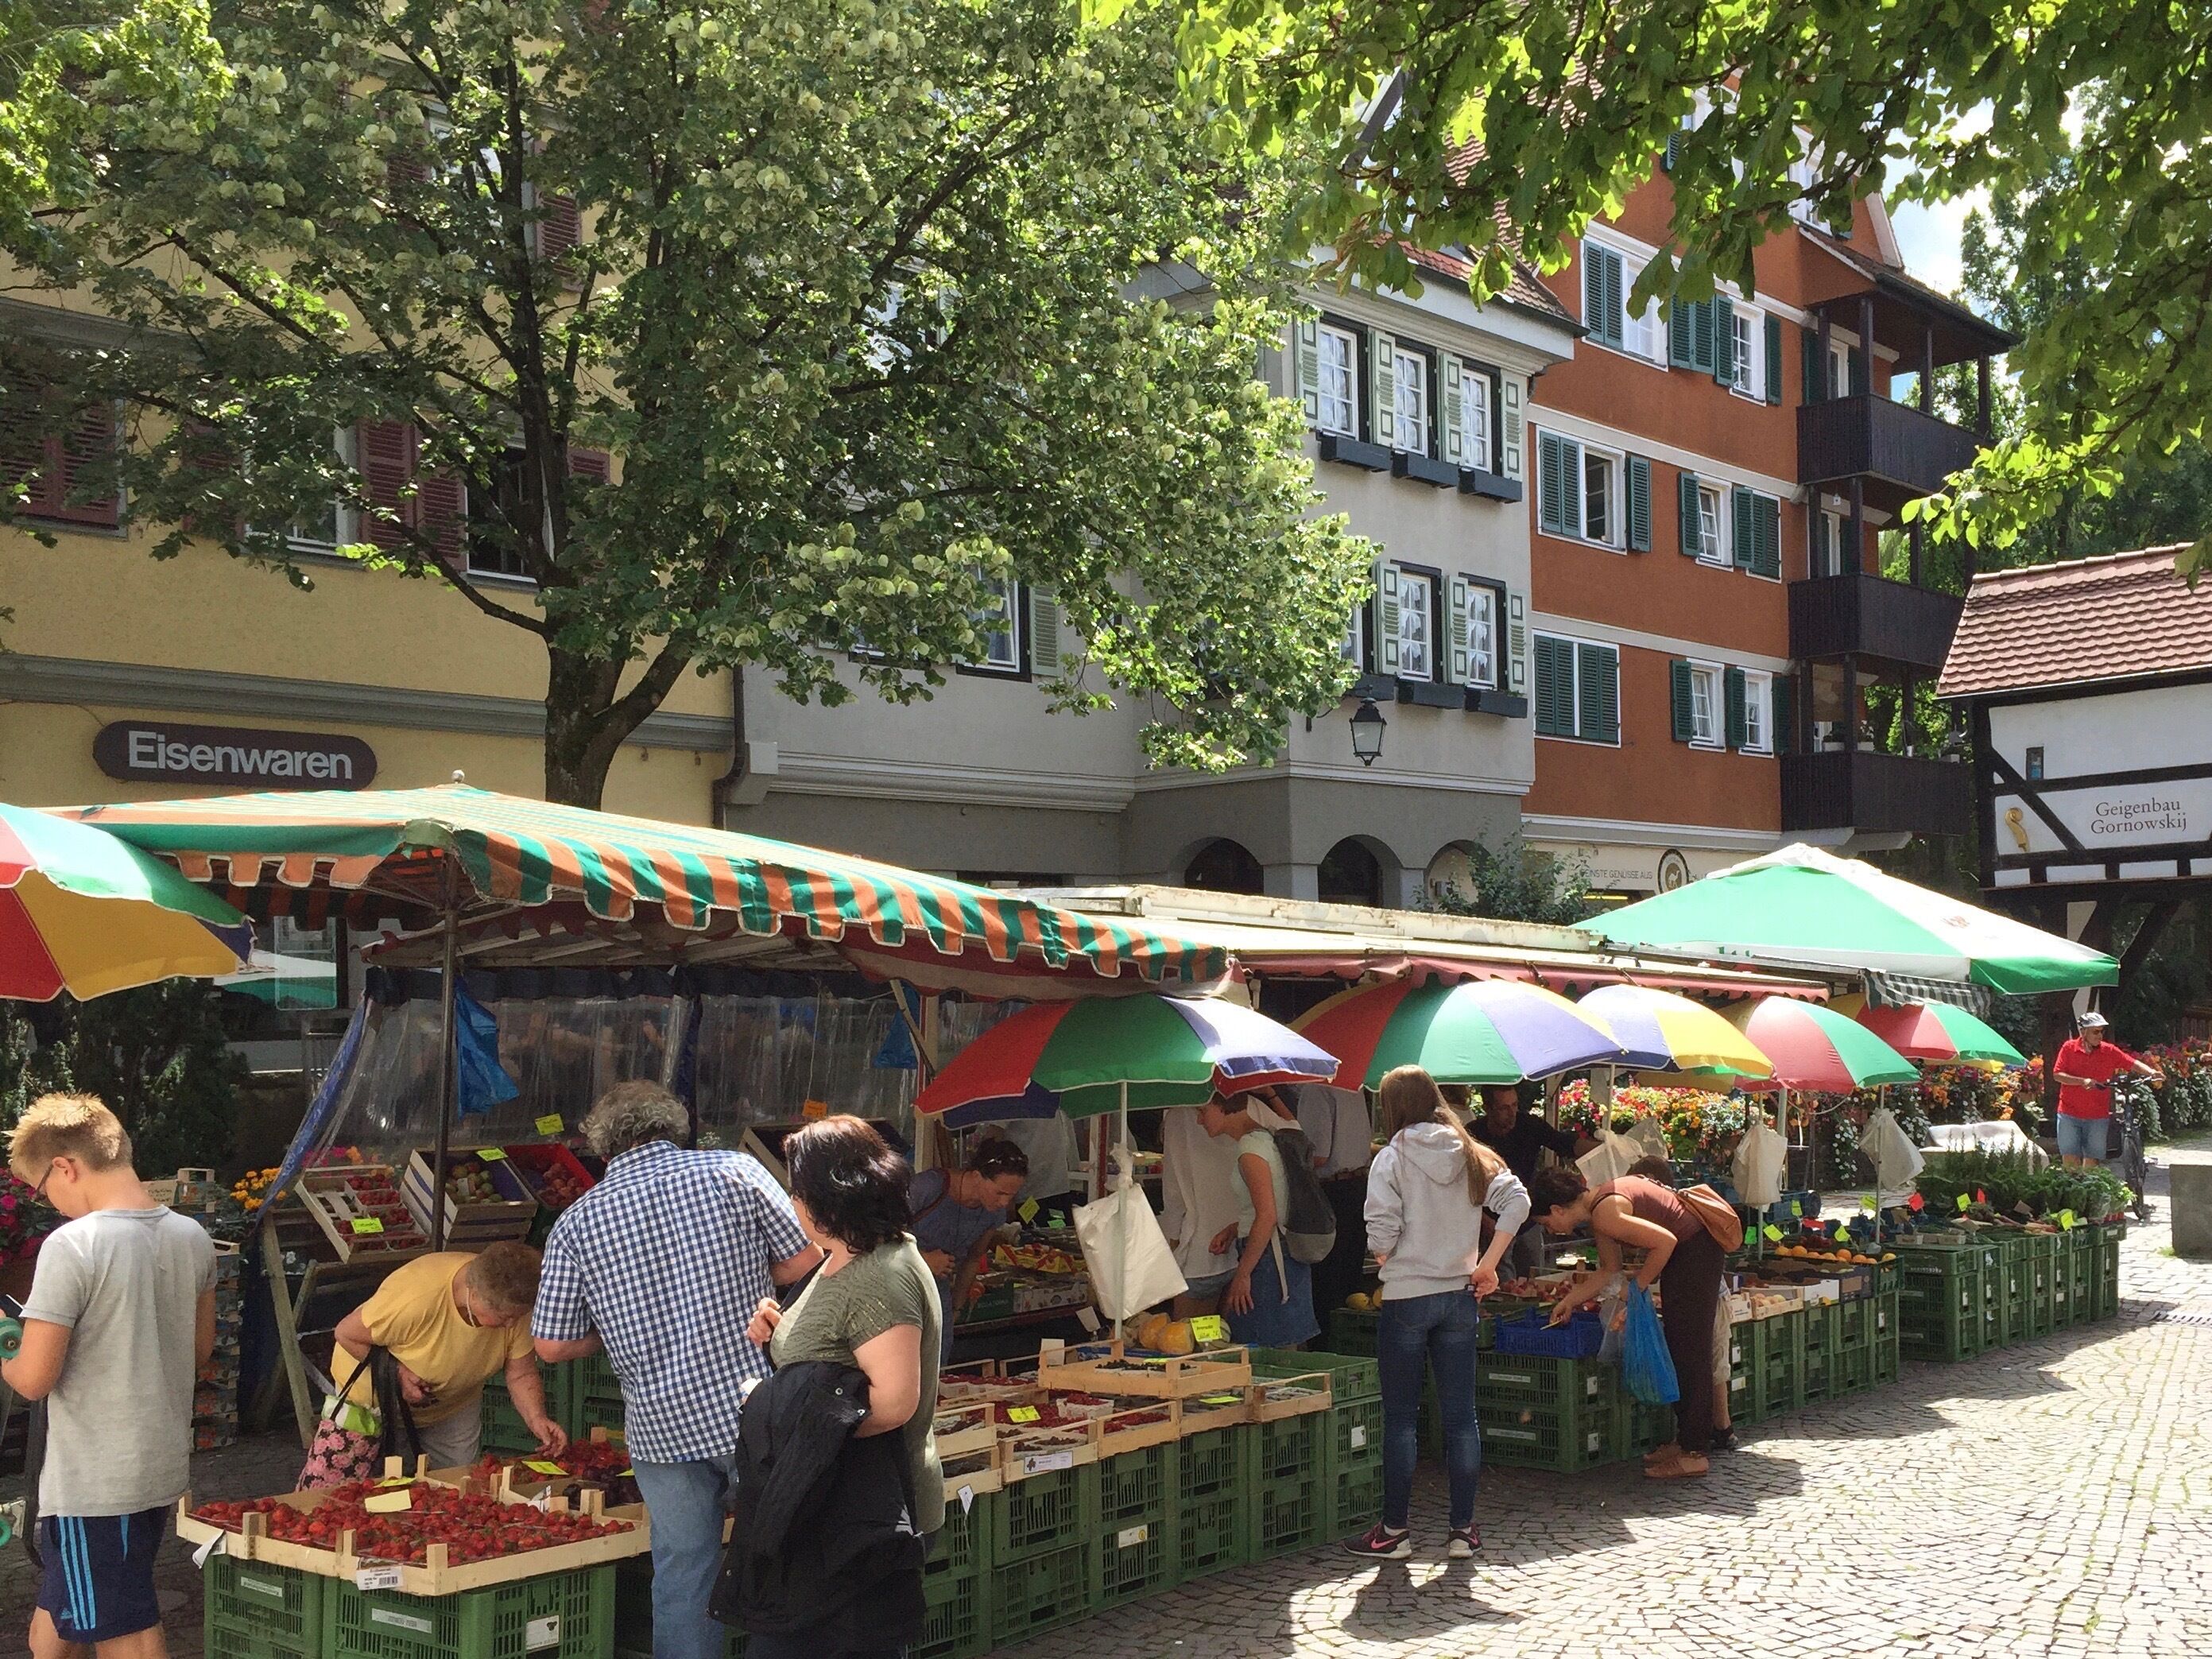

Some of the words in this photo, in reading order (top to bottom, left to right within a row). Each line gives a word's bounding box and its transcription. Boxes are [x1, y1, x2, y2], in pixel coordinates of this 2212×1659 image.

[128, 730, 352, 780] Eisenwaren
[2095, 797, 2181, 820] Geigenbau
[2090, 812, 2187, 834] Gornowskij
[1640, 870, 1652, 879] AUS
